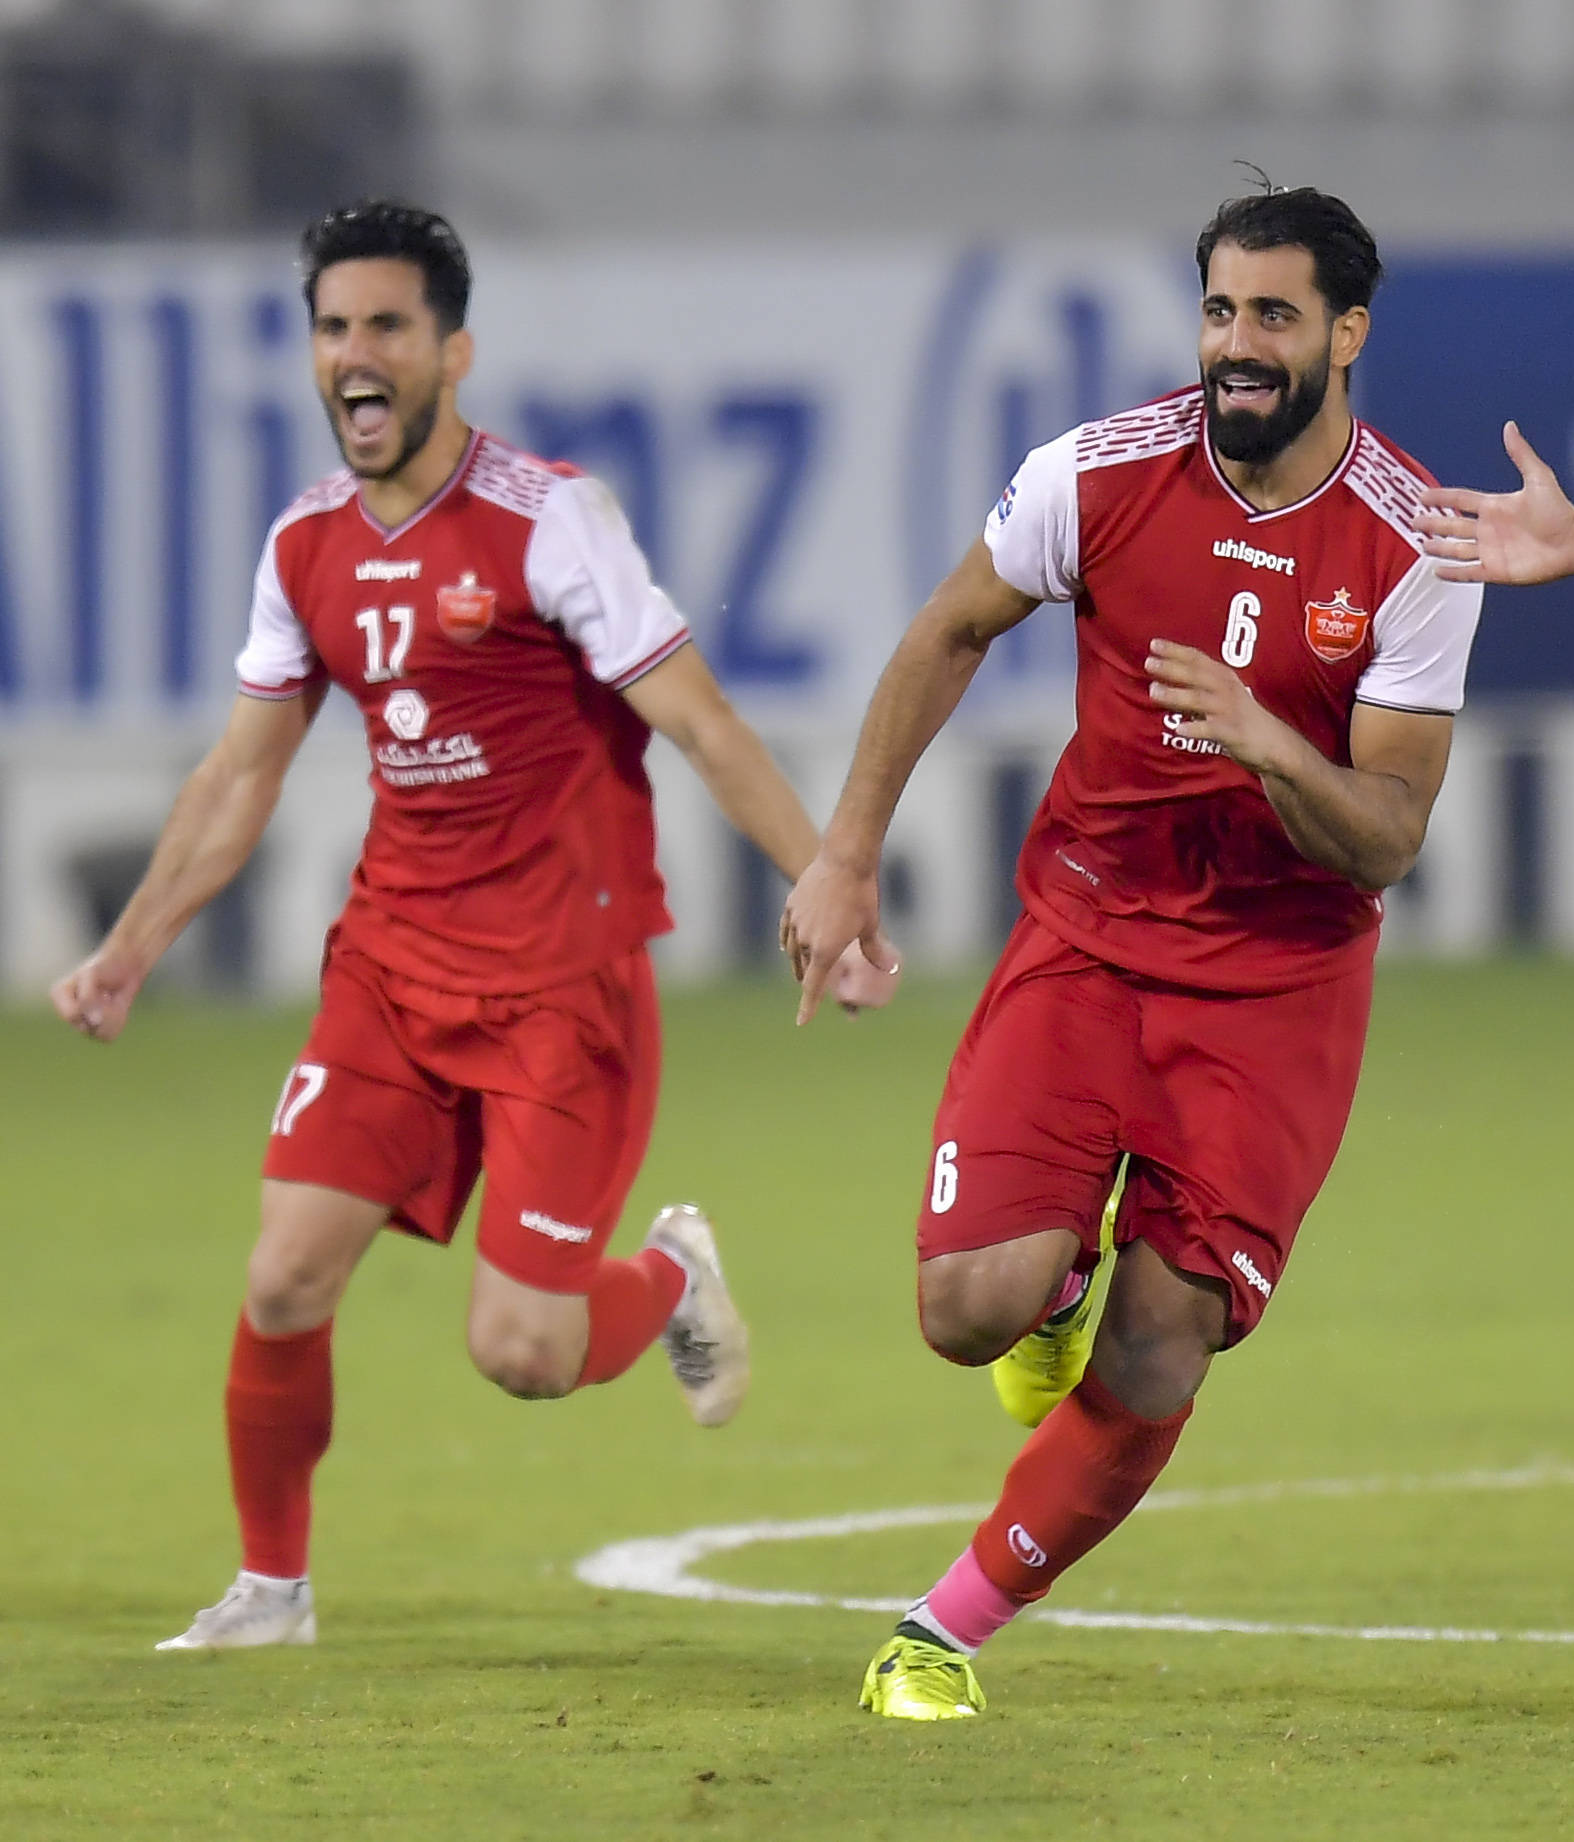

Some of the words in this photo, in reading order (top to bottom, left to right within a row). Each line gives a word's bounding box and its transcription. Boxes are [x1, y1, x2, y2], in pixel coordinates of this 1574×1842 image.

[1212, 538, 1296, 577] uhlsport
[355, 605, 416, 684] 17
[1221, 590, 1262, 669] 6
[1160, 731, 1232, 760] TOURI
[930, 1139, 960, 1215] 6
